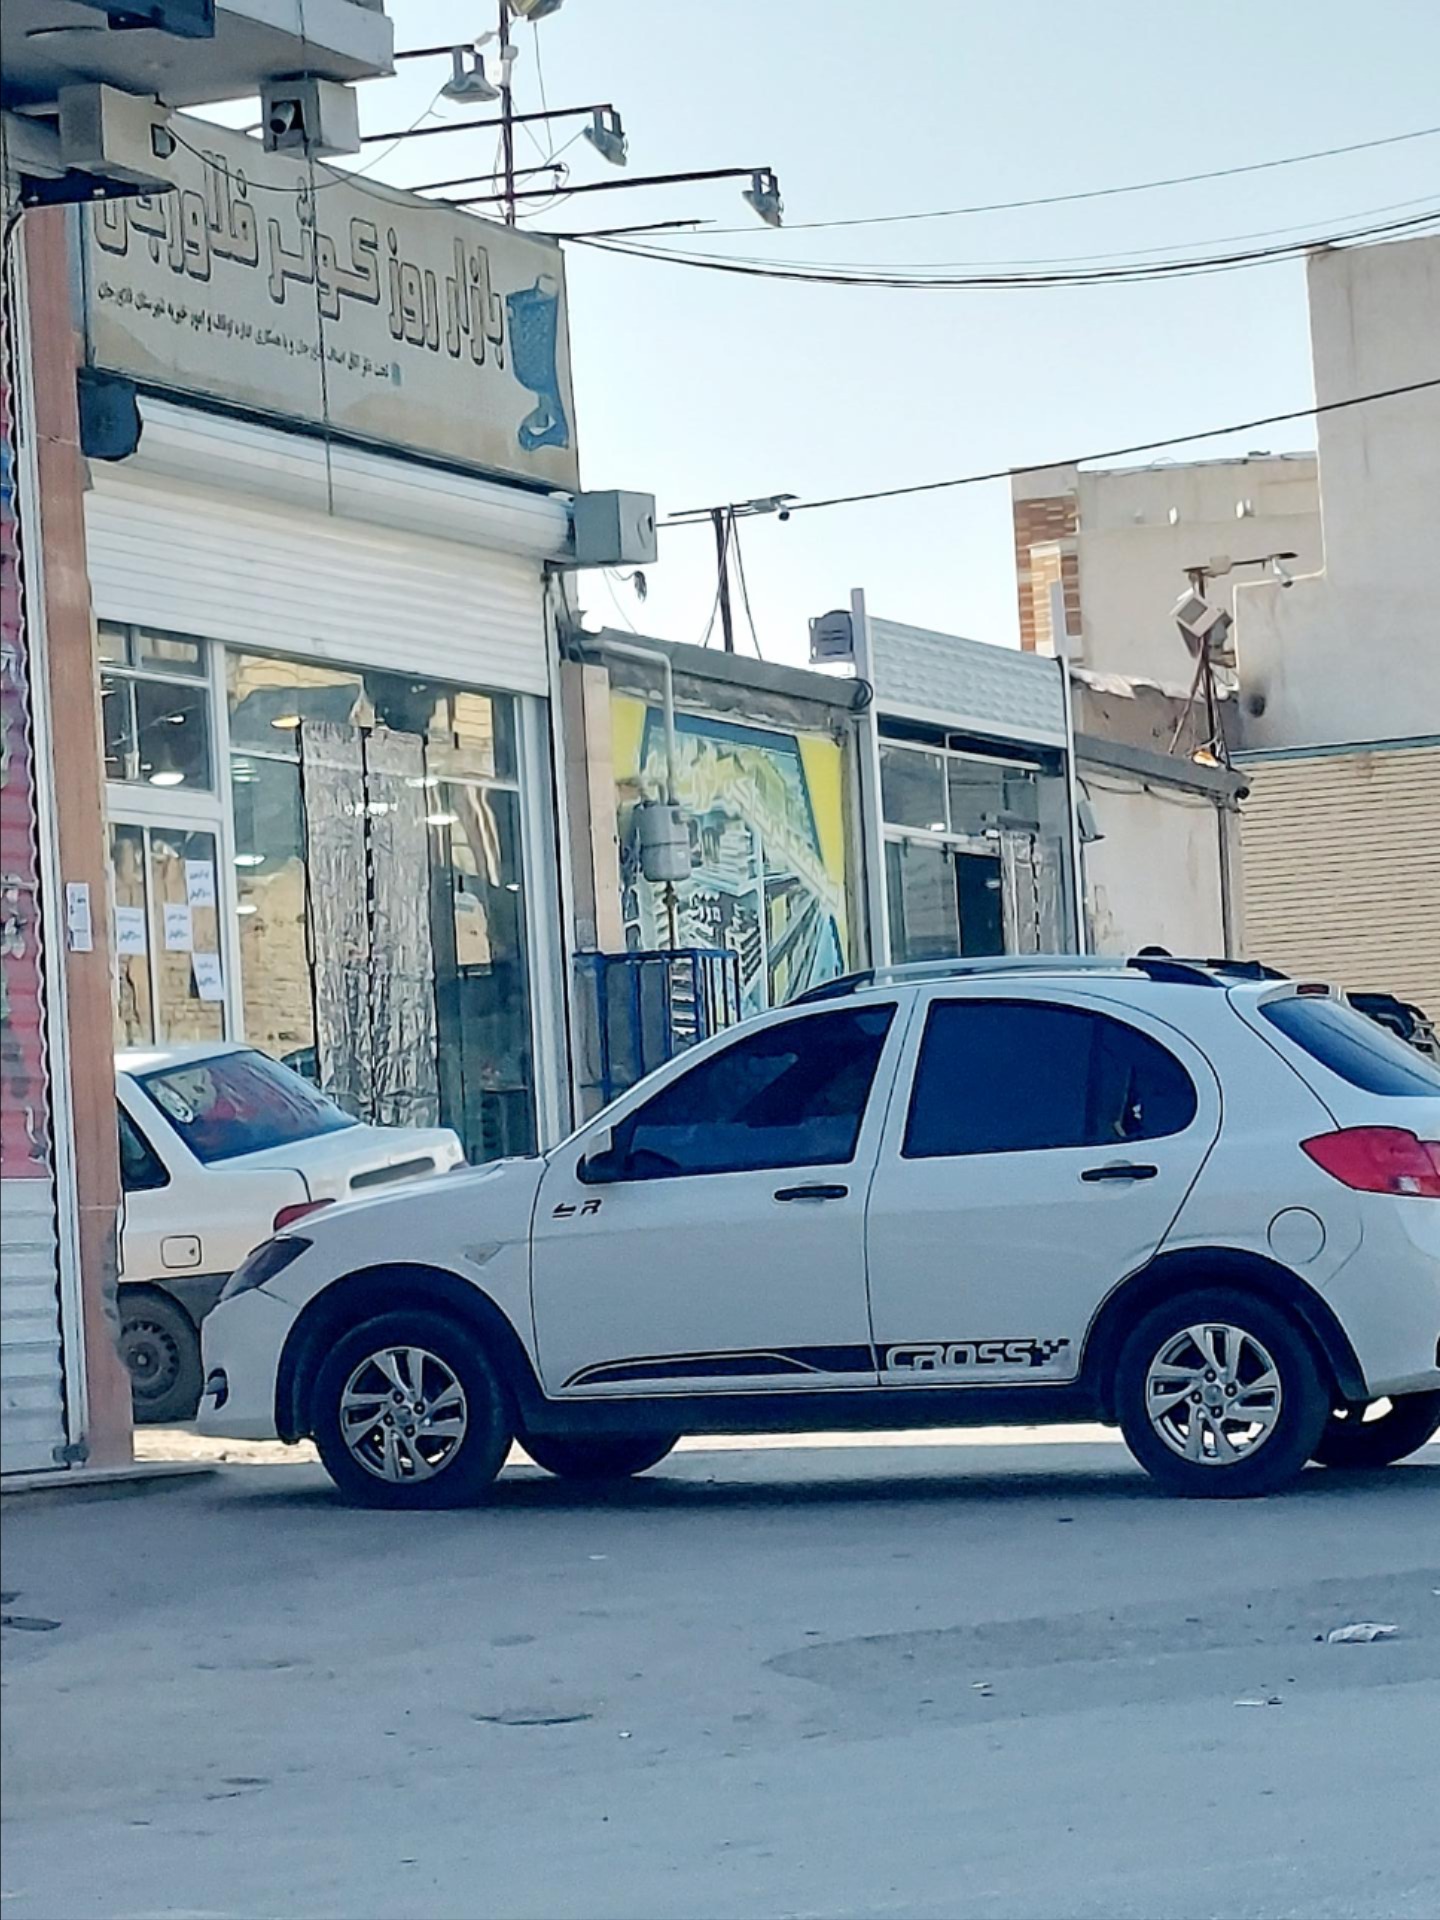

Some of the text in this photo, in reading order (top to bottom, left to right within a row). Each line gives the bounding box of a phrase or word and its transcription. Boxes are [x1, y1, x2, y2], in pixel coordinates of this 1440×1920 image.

[388, 227, 440, 352] روز
[446, 237, 504, 370] بازار
[885, 1342, 1033, 1372] CROSS
